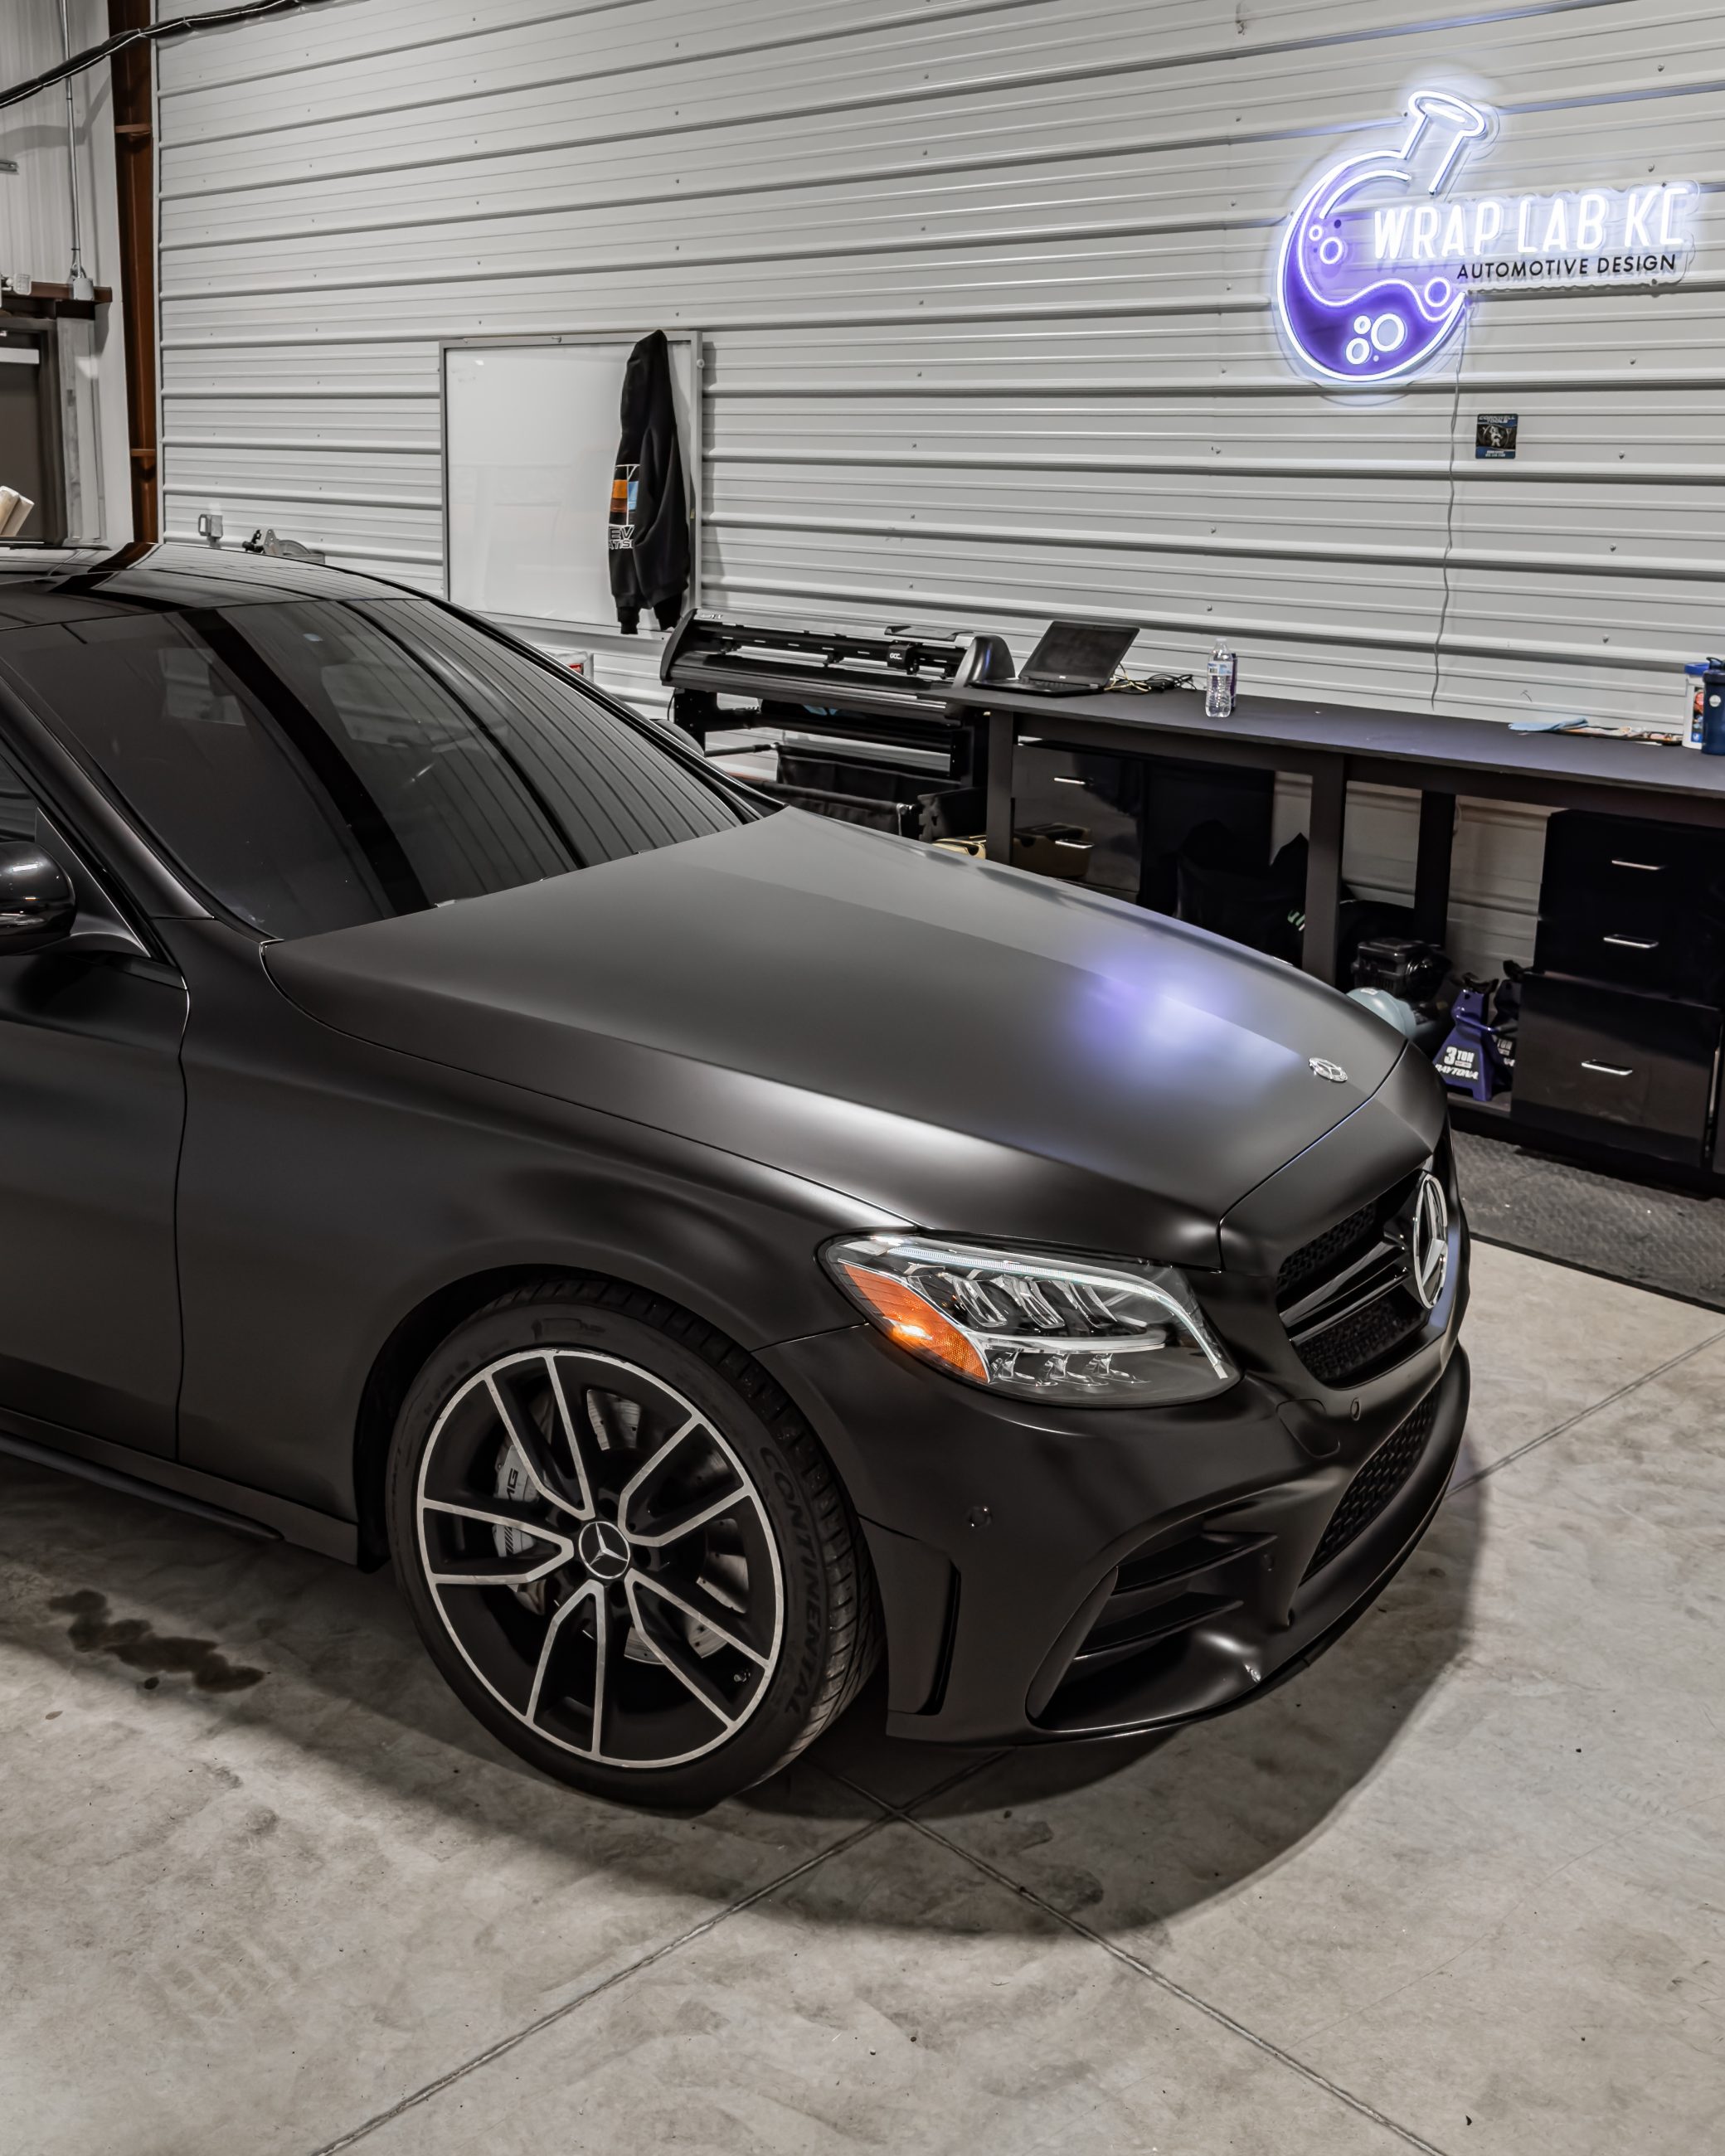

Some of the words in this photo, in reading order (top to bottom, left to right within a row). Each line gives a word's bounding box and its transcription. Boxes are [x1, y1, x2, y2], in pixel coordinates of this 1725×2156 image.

[1374, 201, 1501, 259] WRAP
[1517, 194, 1606, 253] LAB
[1624, 187, 1689, 248] KC
[1456, 259, 1589, 279] AUTOMOTIVE
[1596, 254, 1676, 274] DESIGN
[1444, 1046, 1458, 1066] 3
[1457, 1050, 1475, 1063] TON
[1435, 1063, 1479, 1080] DAYTONA
[759, 1446, 822, 1715] CONTINENTAL
